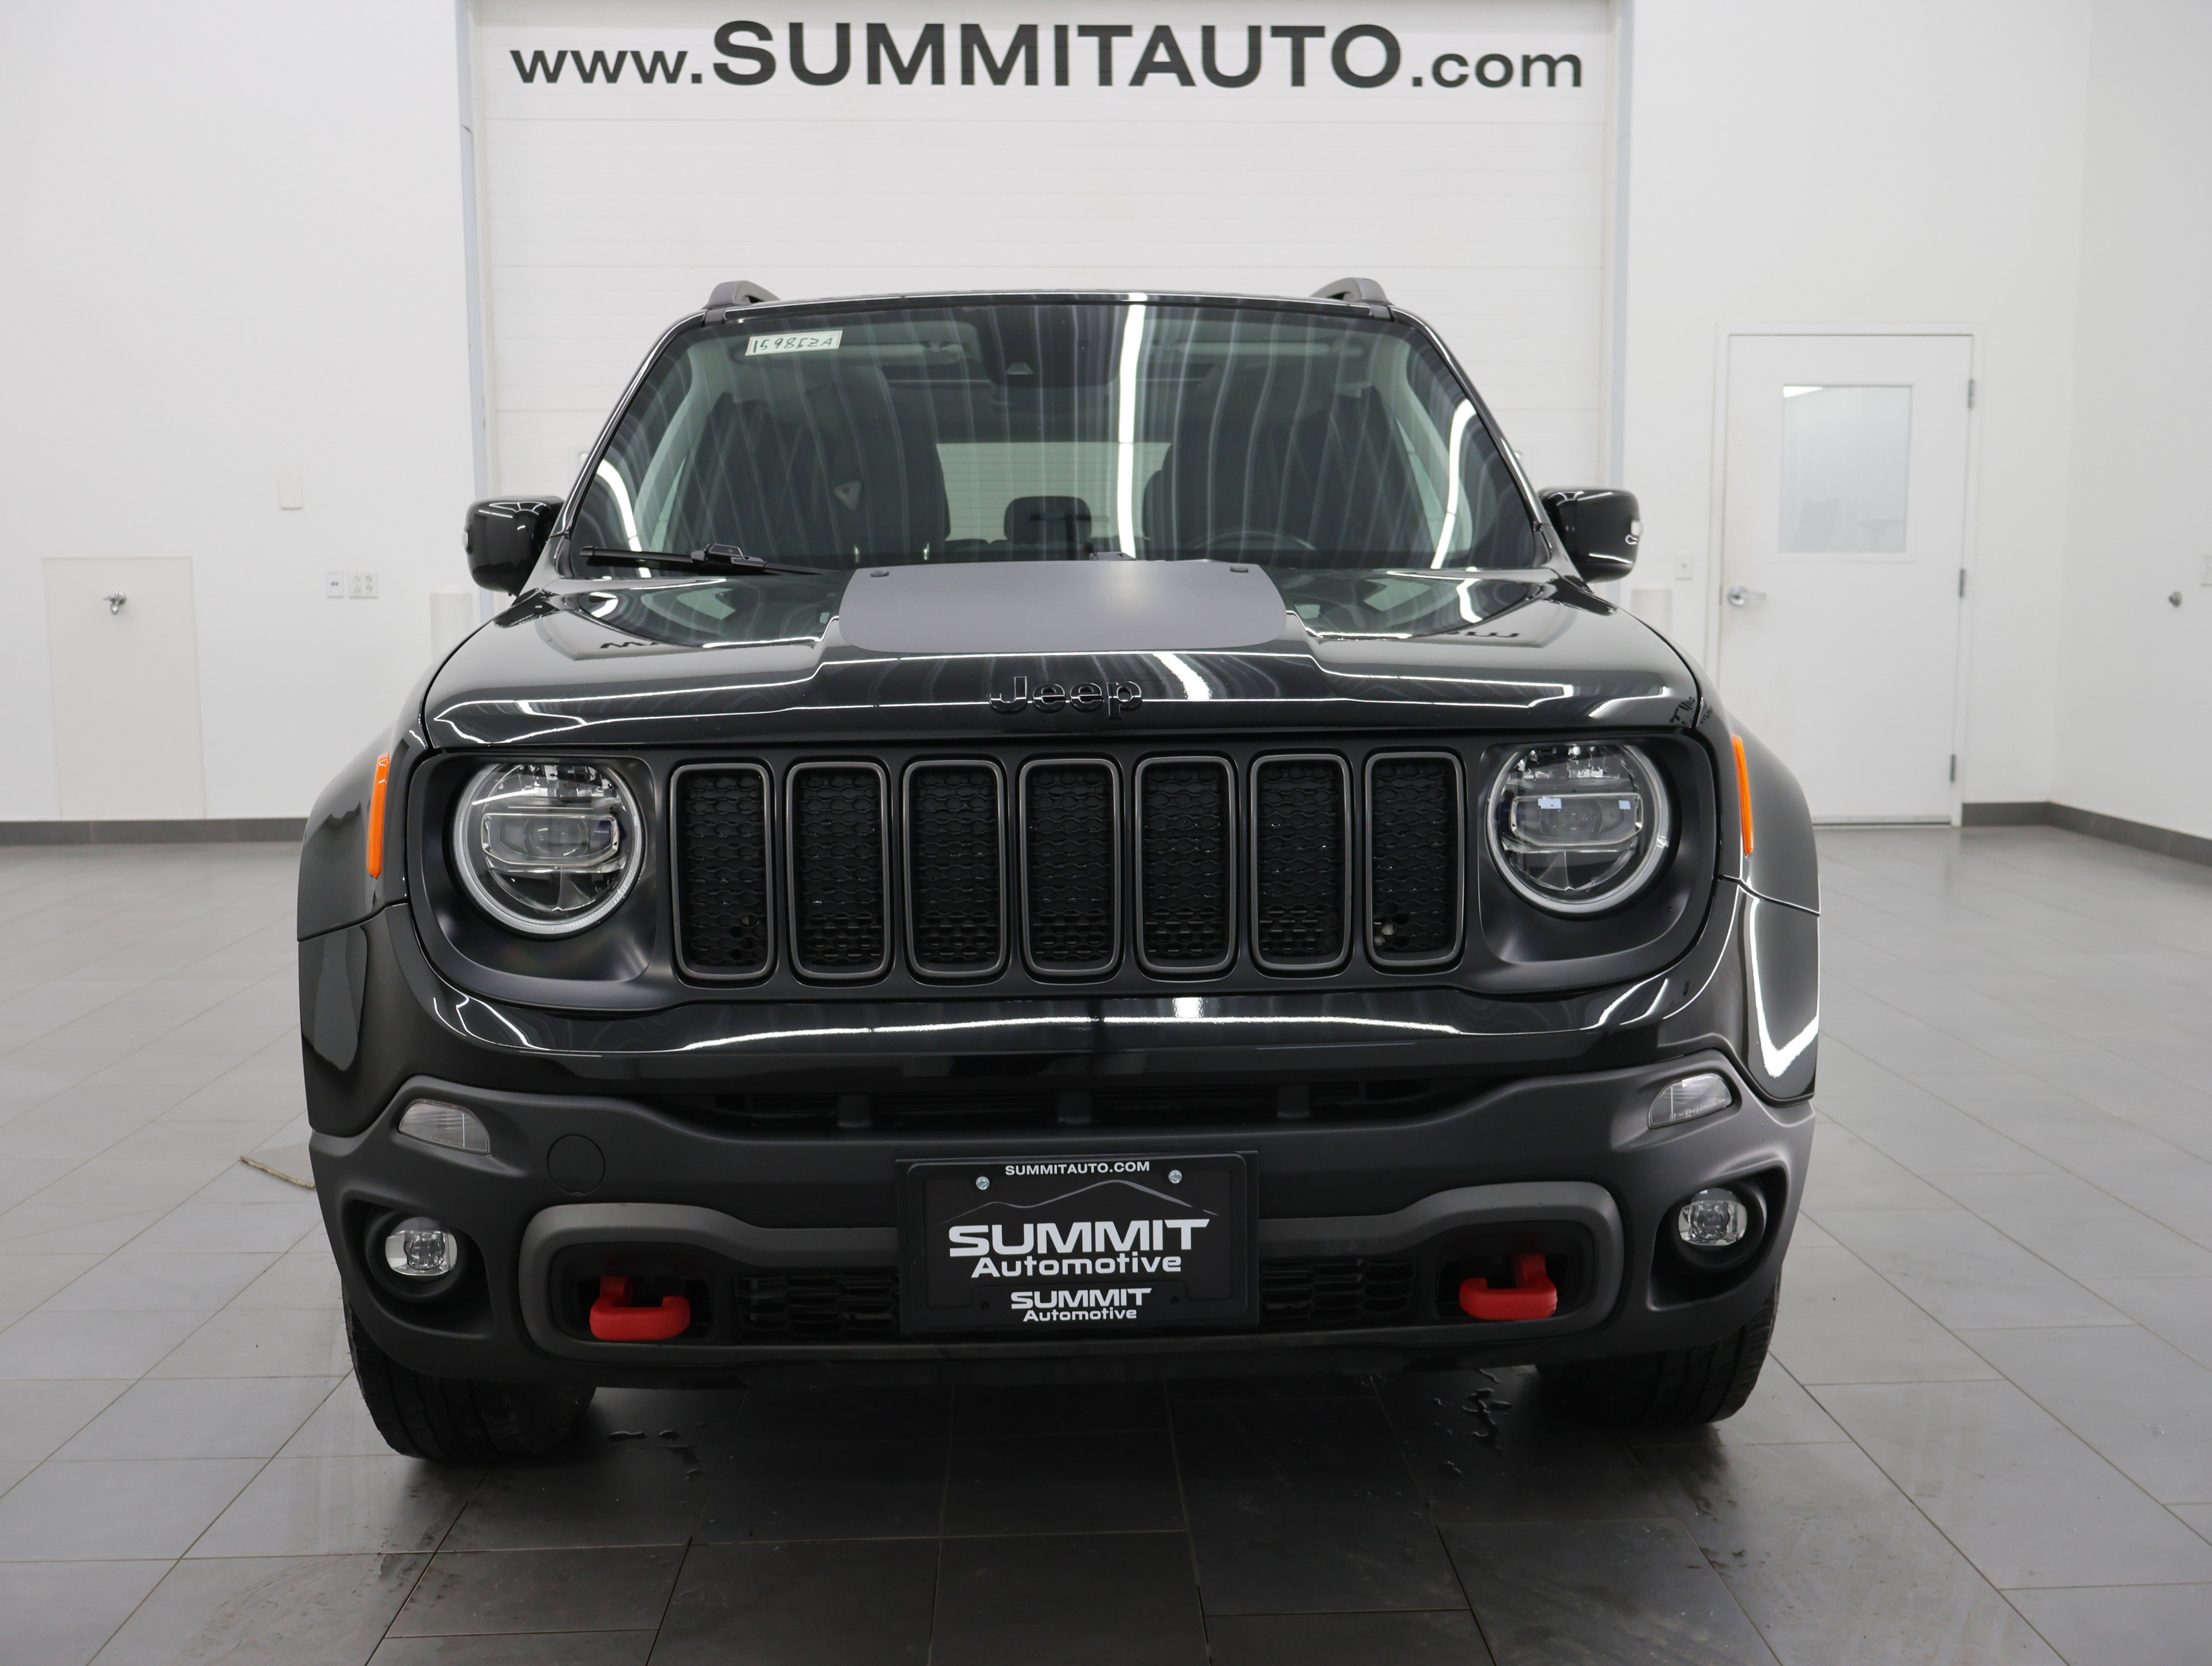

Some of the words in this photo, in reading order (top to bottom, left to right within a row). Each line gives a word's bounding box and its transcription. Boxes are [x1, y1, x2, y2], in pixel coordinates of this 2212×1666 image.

[510, 20, 1581, 88] www.SUMMITAUTO.com
[989, 676, 1143, 719] Jeep
[1005, 1161, 1150, 1175] SUMMITAUTO.COM
[948, 1218, 1210, 1257] SUMMIT
[971, 1251, 1181, 1278] Automotive
[1011, 1288, 1152, 1309] SUMMIT
[1023, 1307, 1137, 1322] Automotive
